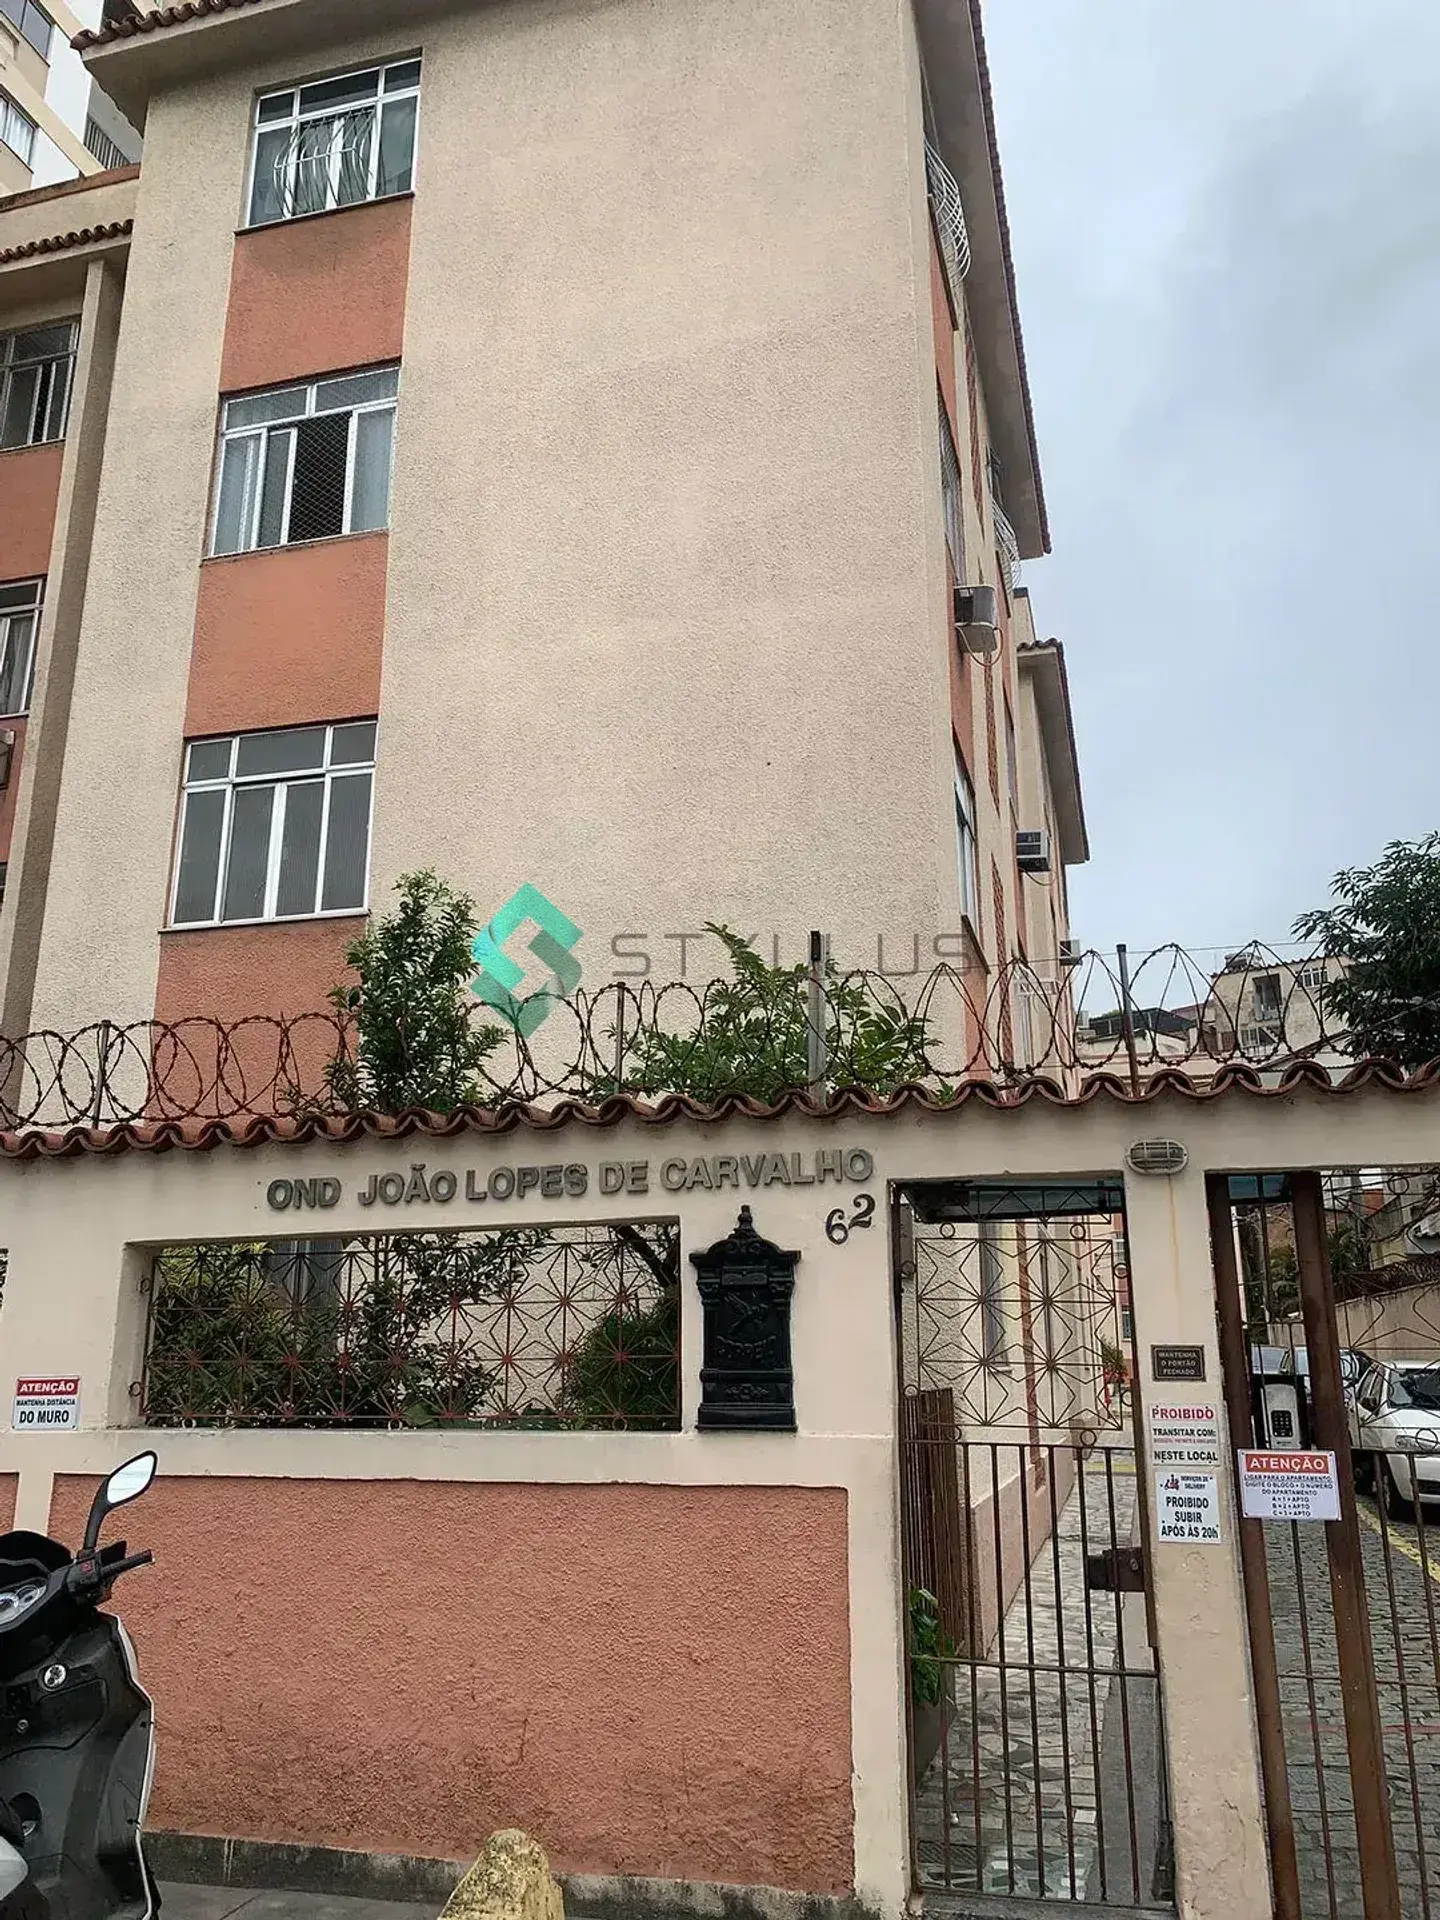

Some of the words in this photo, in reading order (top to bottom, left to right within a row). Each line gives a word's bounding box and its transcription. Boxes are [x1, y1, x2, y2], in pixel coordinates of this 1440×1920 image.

[267, 1177, 342, 1210] OND
[358, 1163, 458, 1206] JOÃO
[465, 1162, 588, 1202] LOPES
[599, 1161, 649, 1194] DE
[660, 1148, 873, 1191] CARVALHO
[825, 1194, 876, 1245] 62
[20, 1381, 75, 1394] ATENÇÃO
[19, 1410, 34, 1423] DO
[37, 1410, 70, 1423] MURO
[1152, 1408, 1214, 1420] PROIBIDO
[1153, 1428, 1195, 1436] TRANSITAR
[1154, 1451, 1185, 1460] NESTE
[1187, 1451, 1219, 1461] LOCAL
[1250, 1457, 1325, 1471] ATENÇÃO
[1166, 1497, 1209, 1508] PROIBIDO
[1174, 1511, 1203, 1523] SUBIR
[1161, 1523, 1186, 1537] APÓS
